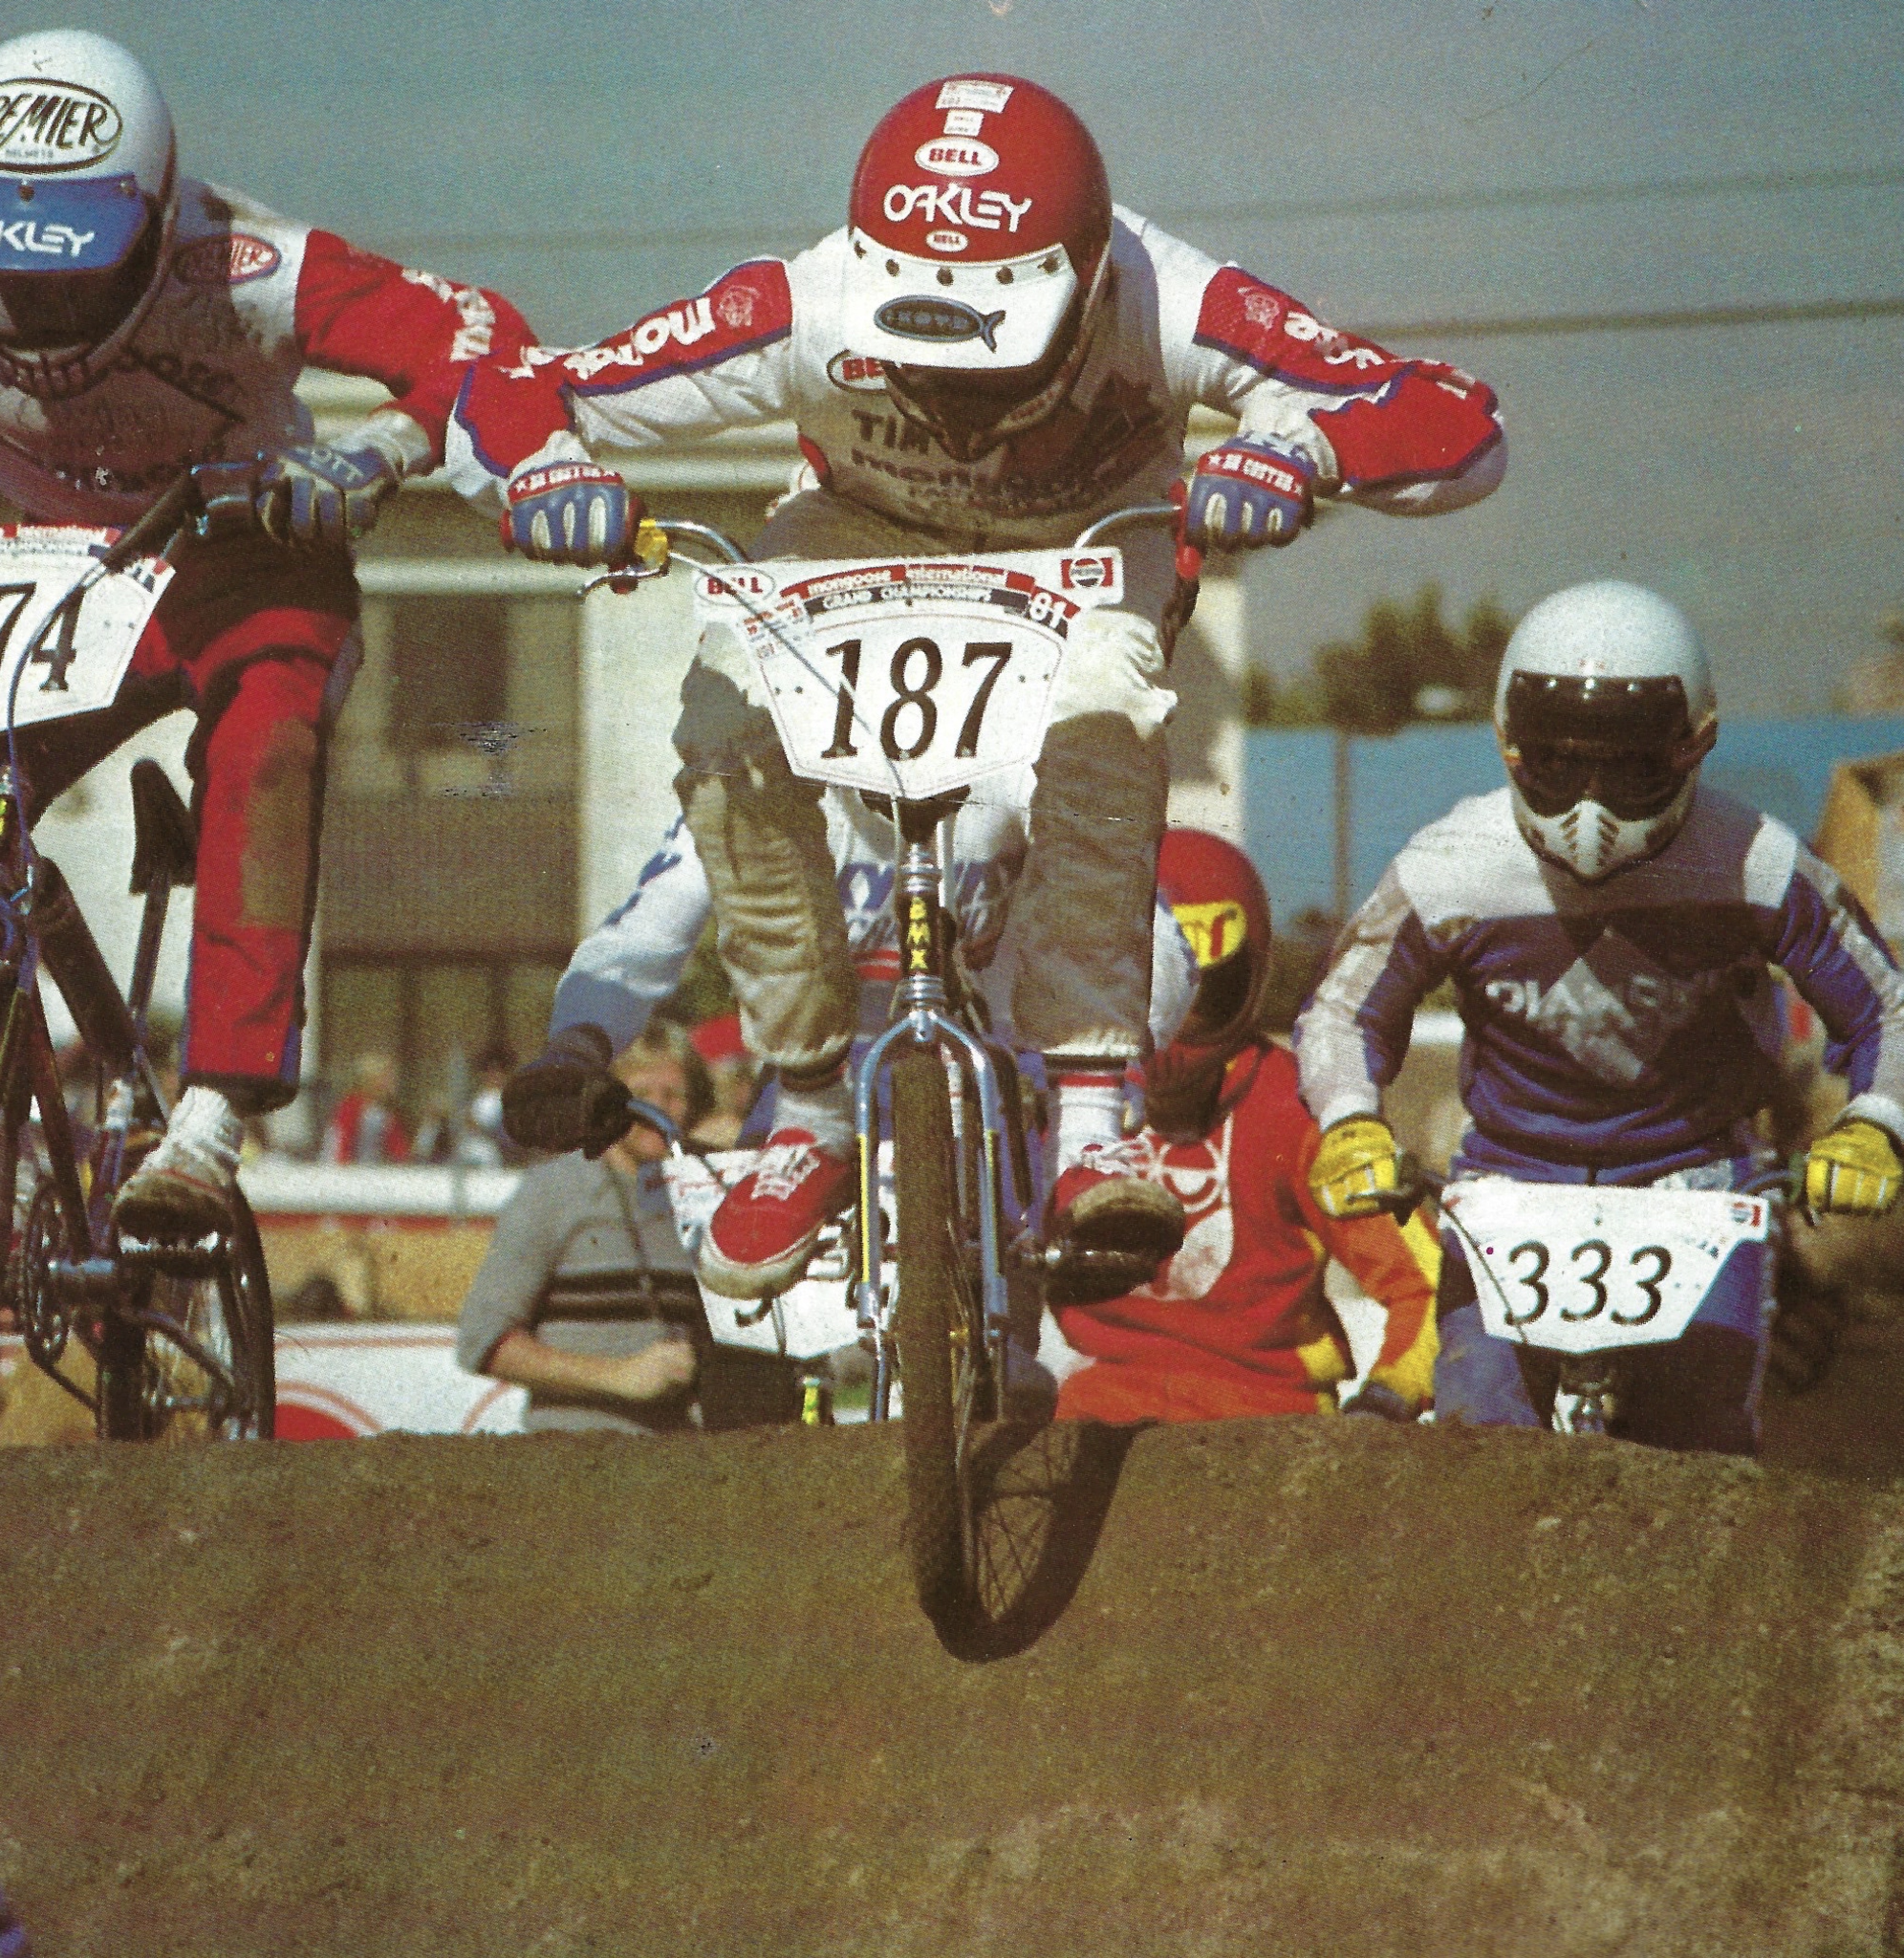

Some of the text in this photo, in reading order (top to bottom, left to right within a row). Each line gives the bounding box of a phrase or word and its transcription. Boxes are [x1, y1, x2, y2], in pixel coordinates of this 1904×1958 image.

[929, 148, 982, 166] BELL
[884, 182, 1033, 232] OAKLEY
[842, 357, 886, 381] BE
[707, 577, 763, 594] BL
[822, 589, 873, 610] GRAND
[1029, 591, 1067, 630] 81
[820, 637, 1012, 761] 187
[1504, 1239, 1672, 1327] 333
